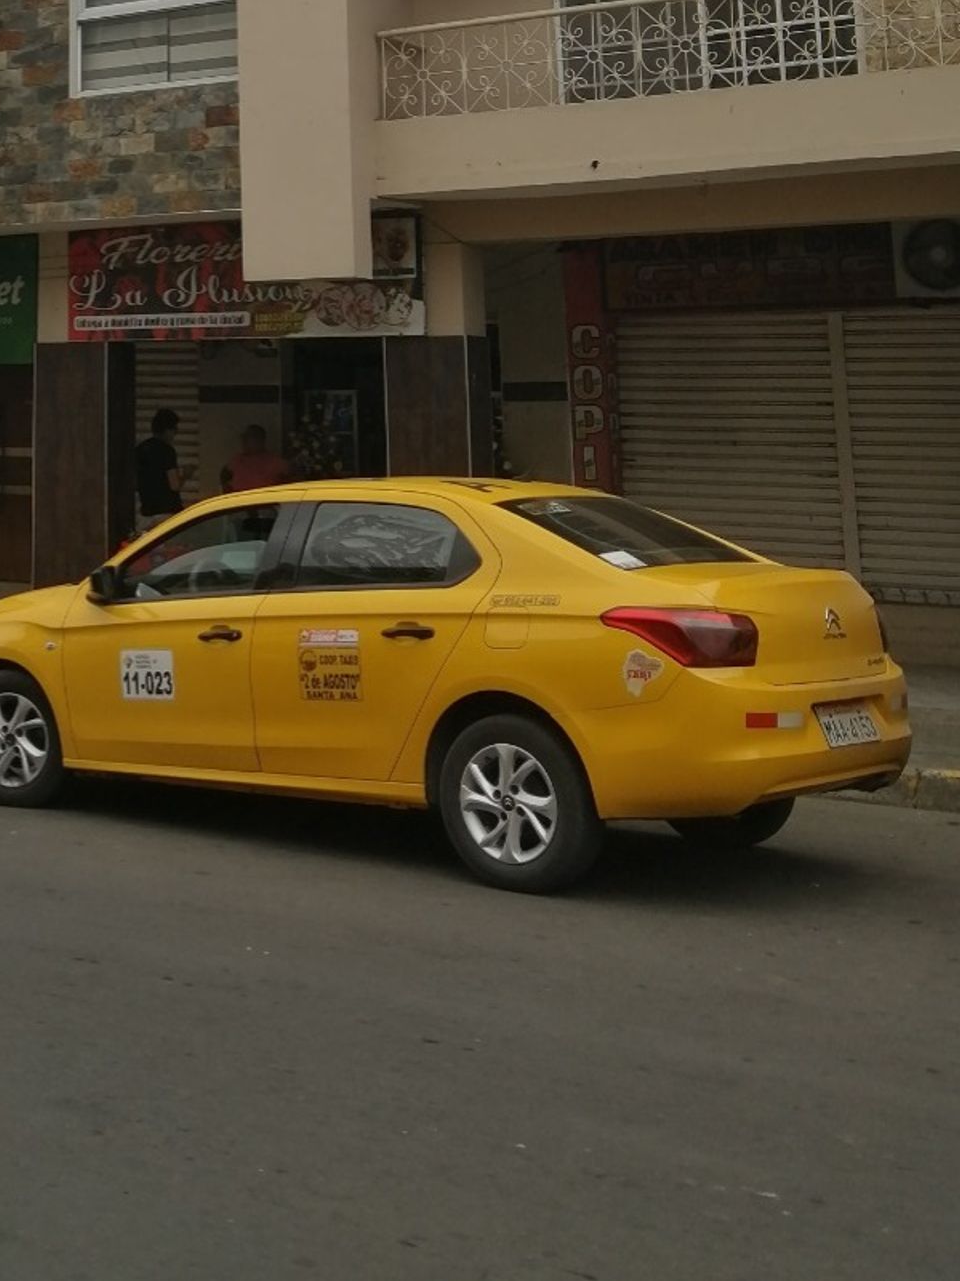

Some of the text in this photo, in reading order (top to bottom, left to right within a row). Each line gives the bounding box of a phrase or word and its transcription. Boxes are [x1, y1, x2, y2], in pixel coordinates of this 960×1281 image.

[69, 269, 147, 311] La
[123, 671, 174, 695] 11-023
[306, 690, 336, 701] SANTA
